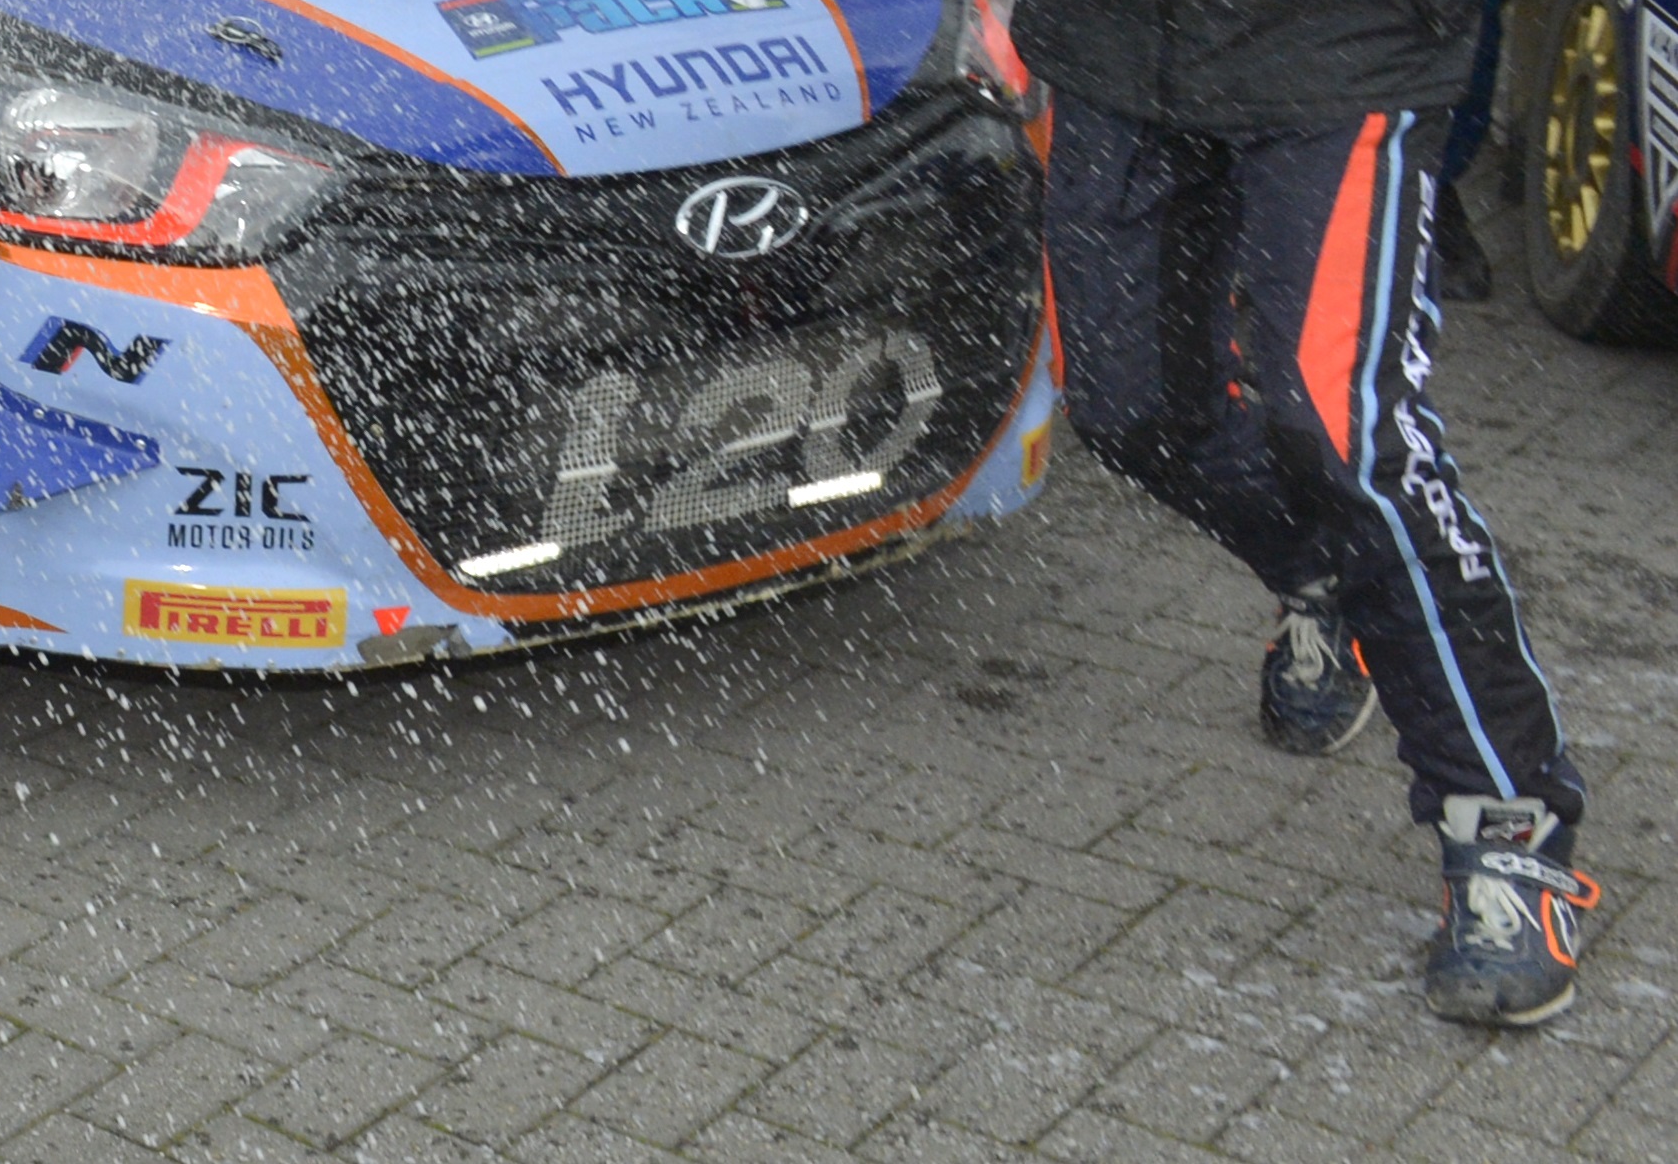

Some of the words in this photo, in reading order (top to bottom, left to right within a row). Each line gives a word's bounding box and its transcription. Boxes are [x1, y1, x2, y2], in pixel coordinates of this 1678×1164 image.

[542, 36, 828, 116] HYUNDAI
[574, 110, 656, 143] NEW
[681, 82, 842, 122] ZEALAND
[174, 466, 312, 523] ZIC
[168, 524, 250, 550] MOTOR
[262, 526, 315, 551] OILS
[139, 592, 332, 638] PIRELLI
